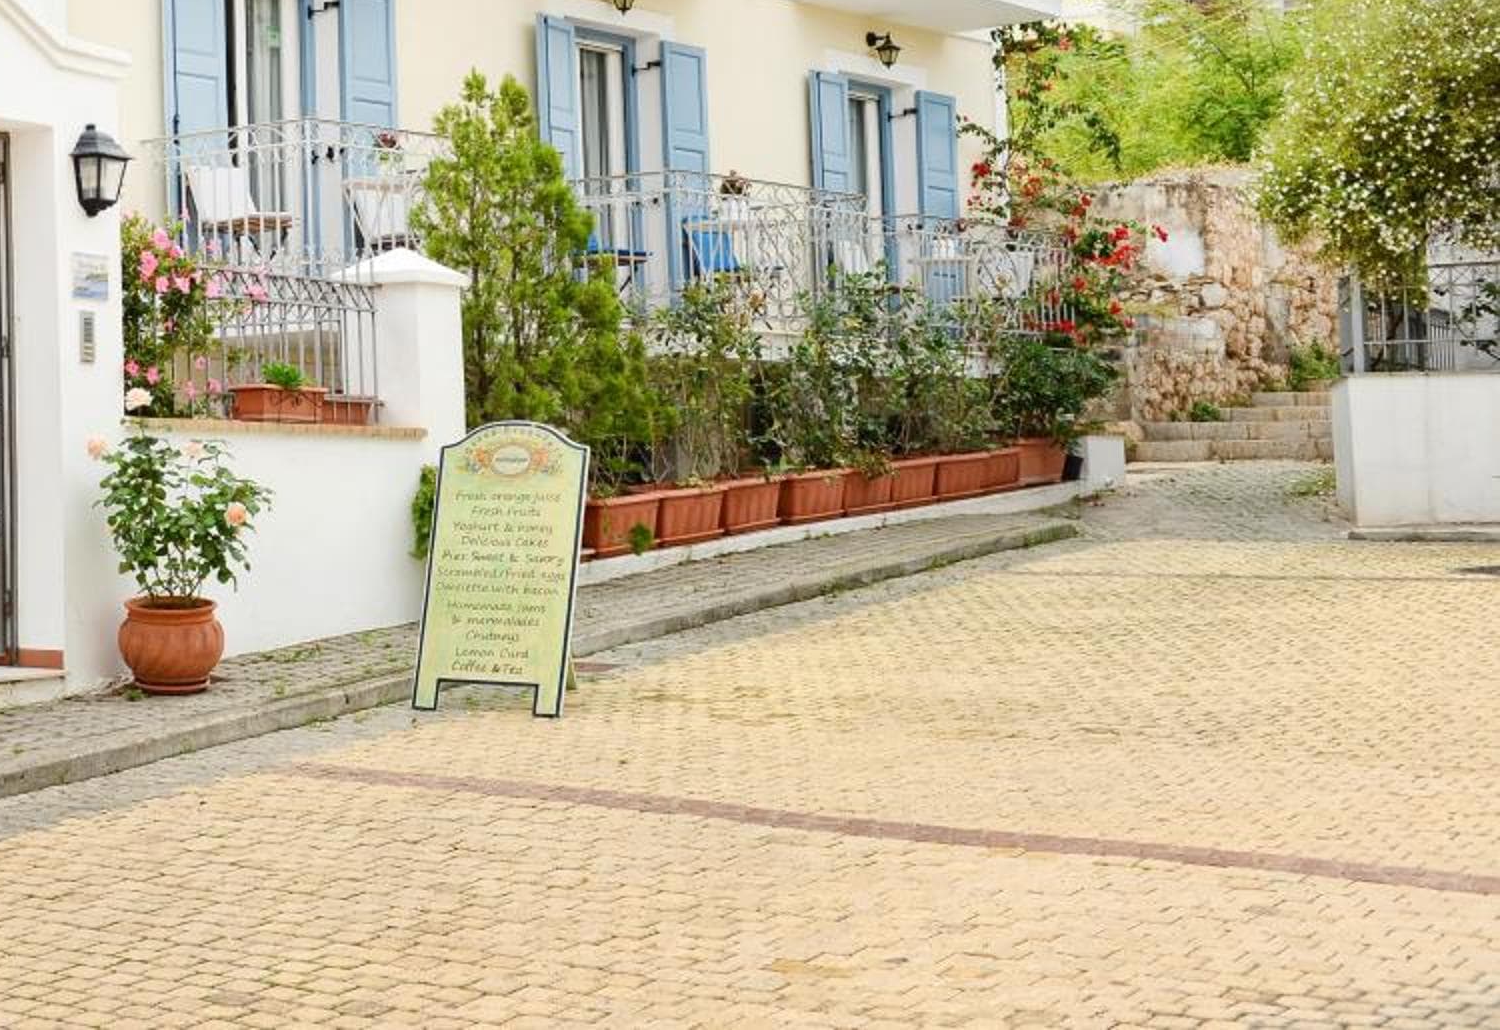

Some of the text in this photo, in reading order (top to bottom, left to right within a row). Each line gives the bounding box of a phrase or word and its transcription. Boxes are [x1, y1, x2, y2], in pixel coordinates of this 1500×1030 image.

[455, 492, 487, 502] Fresh
[491, 493, 531, 504] orange
[471, 505, 502, 516] Fresh
[453, 520, 499, 533] Yoghurt
[504, 521, 514, 532] &
[461, 535, 511, 547] Delicious
[509, 553, 519, 563] &
[465, 629, 520, 645] Chutneys
[455, 647, 529, 659] Lemon Curd
[451, 659, 524, 675] Coffee & Tea
